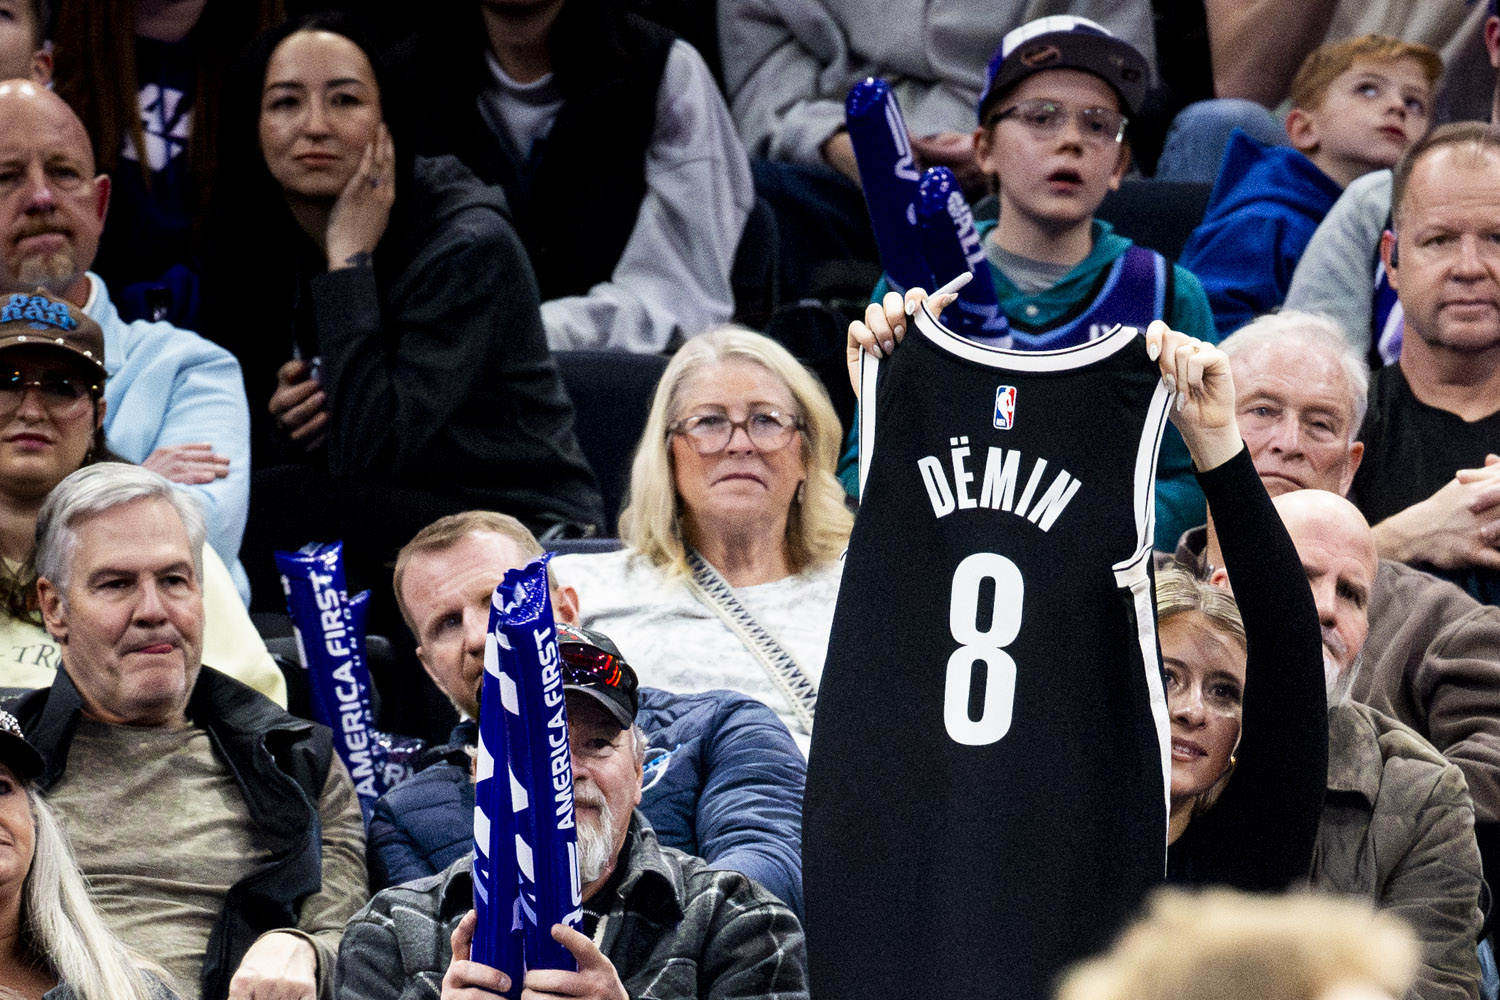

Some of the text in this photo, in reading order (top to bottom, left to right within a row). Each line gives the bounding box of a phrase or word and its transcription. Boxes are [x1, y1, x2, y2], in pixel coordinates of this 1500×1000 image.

[917, 436, 1082, 533] DËMIN
[310, 570, 378, 798] AMERICA FIRST
[533, 627, 577, 831] AMERICA FIRST
[943, 552, 1025, 746] 8
